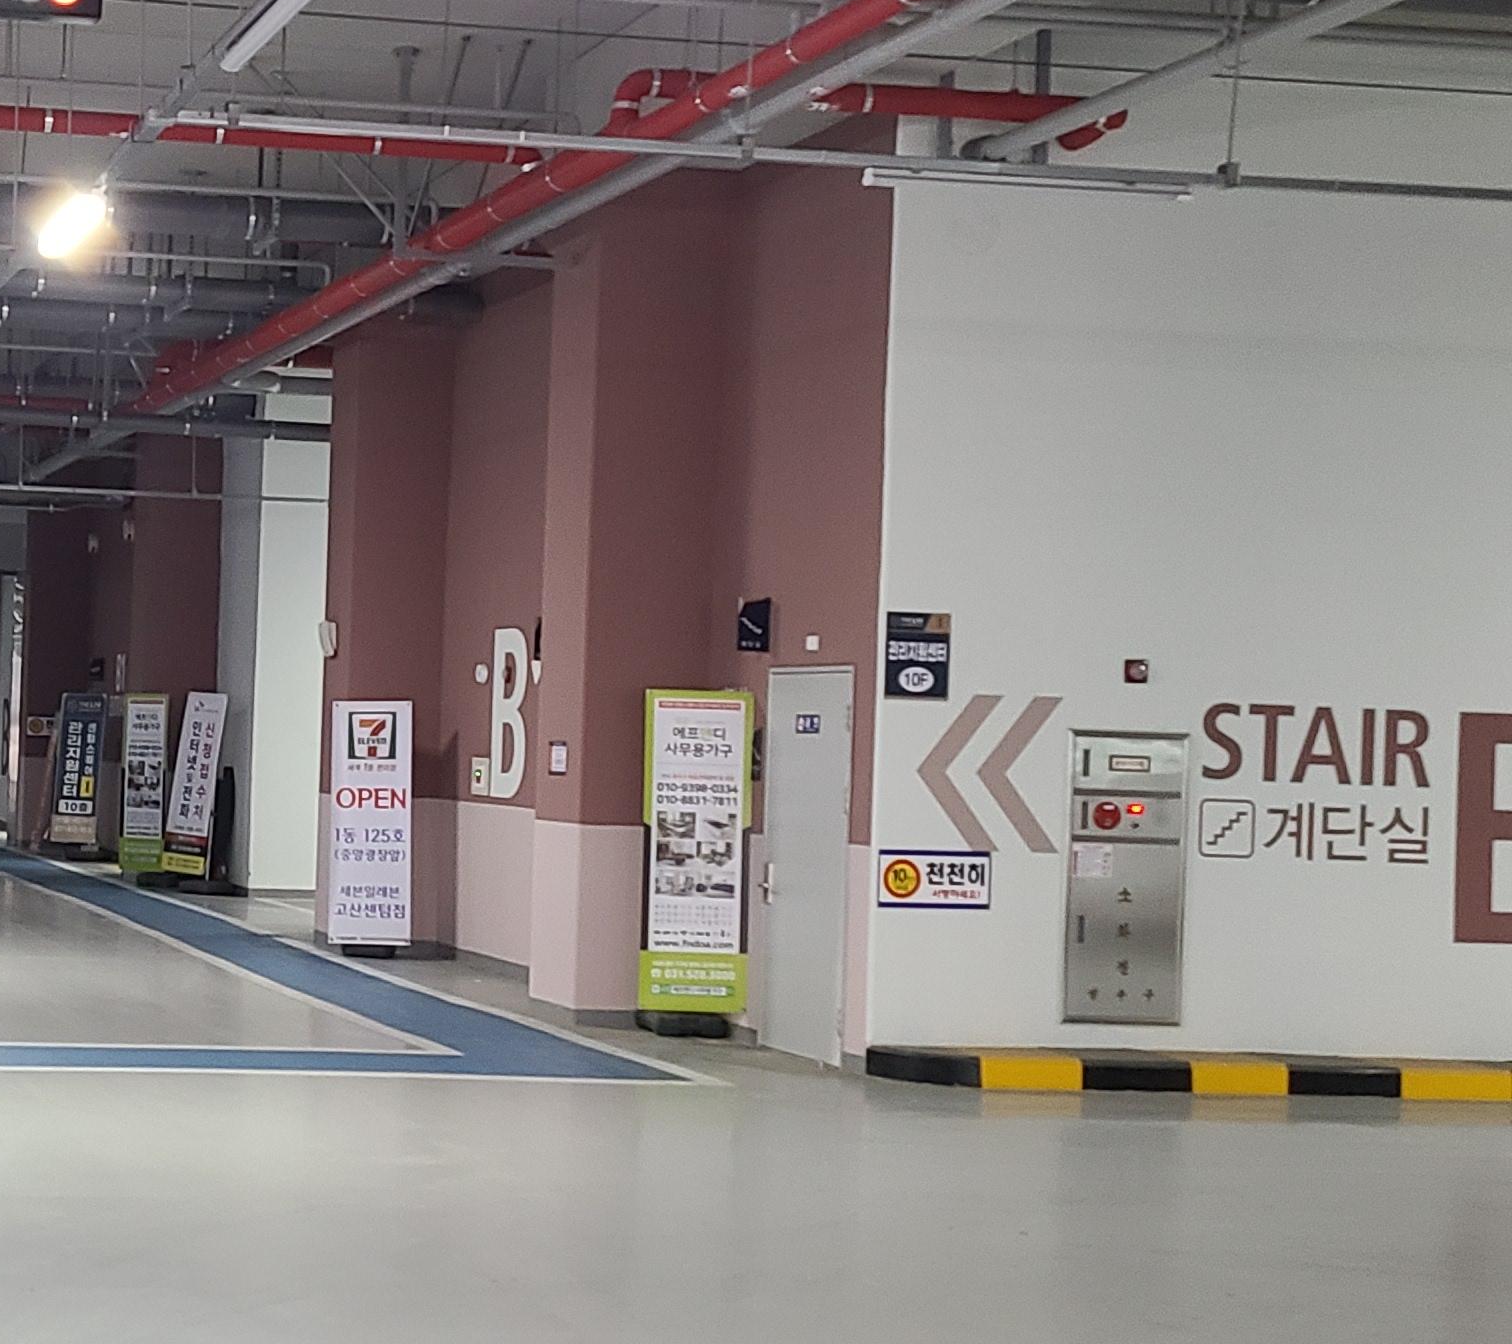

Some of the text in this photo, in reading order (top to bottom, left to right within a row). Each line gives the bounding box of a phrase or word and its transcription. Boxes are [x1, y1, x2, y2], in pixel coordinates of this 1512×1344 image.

[904, 672, 929, 687] 10F
[490, 627, 528, 799] B
[664, 742, 733, 758] 사무용가구
[1201, 702, 1431, 789] STAIR
[336, 787, 407, 809] OPEN
[335, 827, 406, 844] 1동 125호
[1262, 802, 1430, 865] 계단실
[926, 862, 985, 887] 천천히
[341, 885, 400, 899] 세븐일레븐
[334, 903, 406, 920] 고산센텀점
